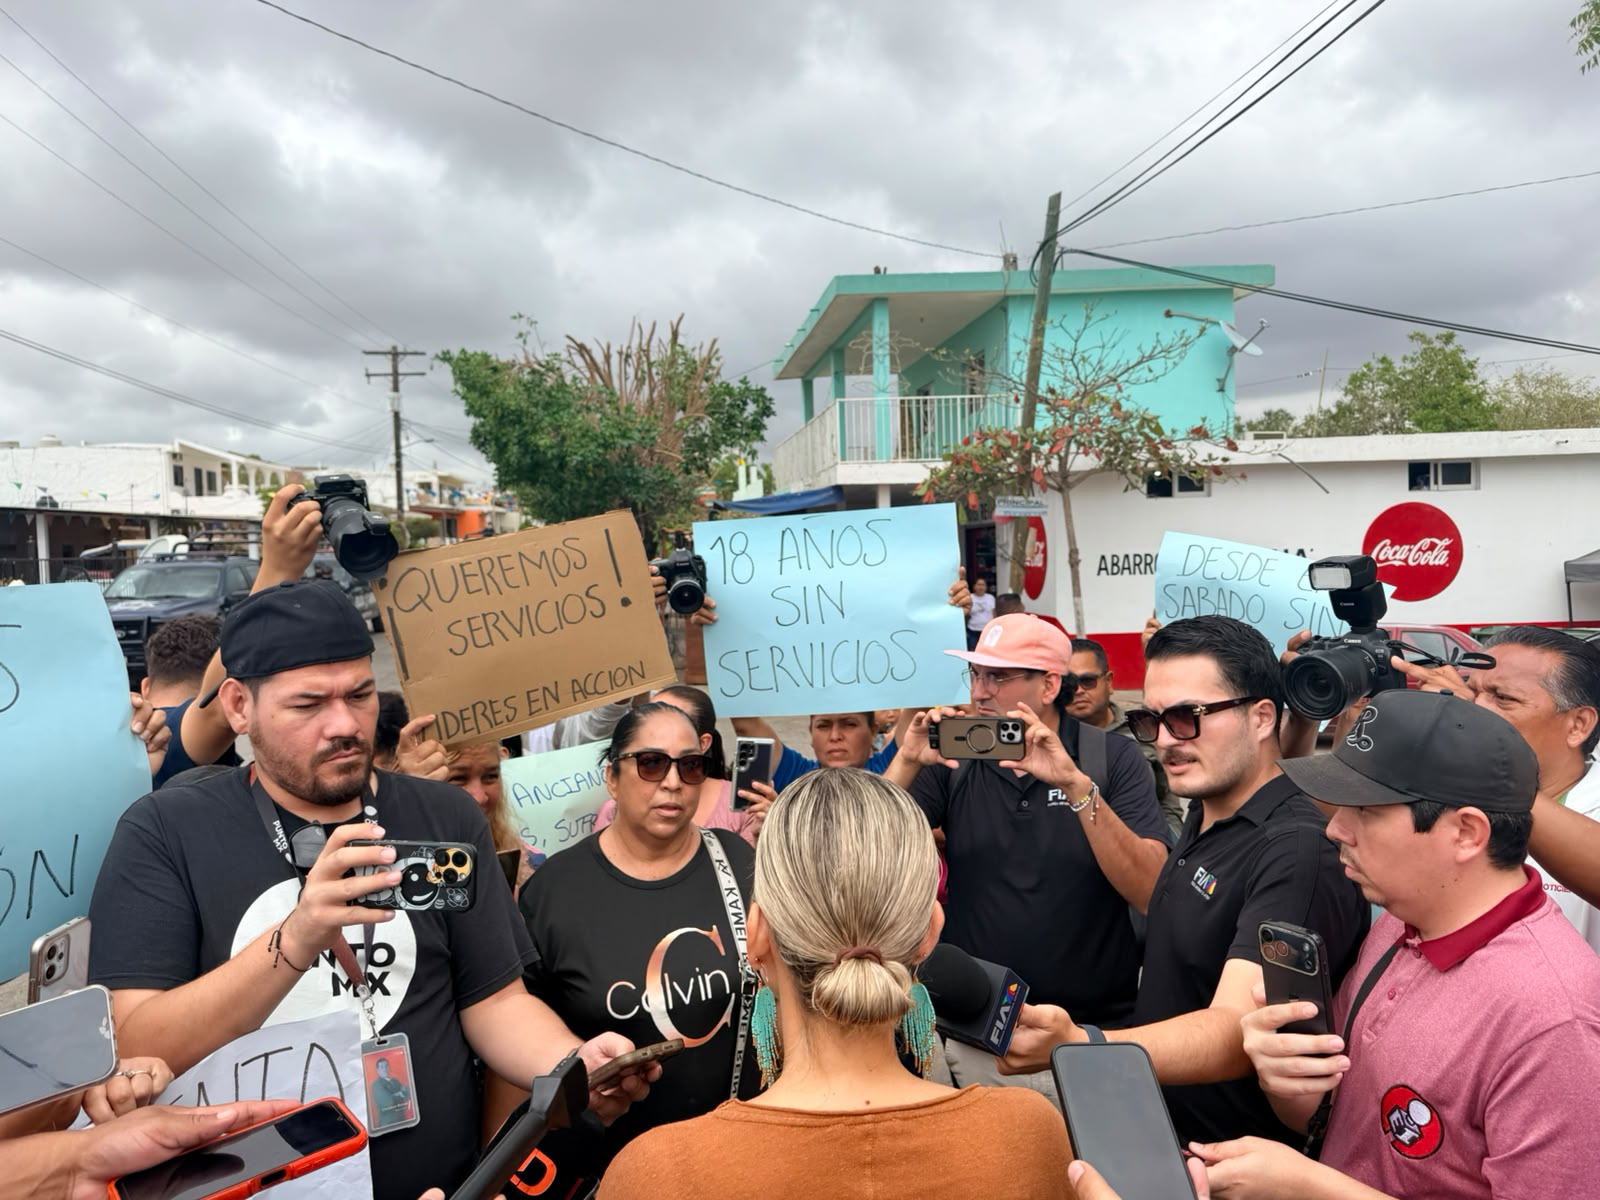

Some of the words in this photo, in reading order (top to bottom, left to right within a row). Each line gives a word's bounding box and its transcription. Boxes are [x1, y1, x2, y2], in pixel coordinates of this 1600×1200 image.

[710, 531, 755, 585] 18
[778, 514, 892, 576] AÑOS
[1096, 552, 1159, 577] ABARR
[1176, 544, 1279, 588] DESDE
[1370, 537, 1455, 567] Coca-Cola
[771, 580, 846, 627] SIN
[1162, 583, 1266, 624] SABADO
[718, 629, 918, 698] SERVICIOS
[526, 680, 561, 717] EN
[571, 660, 647, 703] ACCION
[1047, 788, 1067, 802] FI
[272, 819, 288, 850] PUNTO
[331, 970, 392, 998] MX
